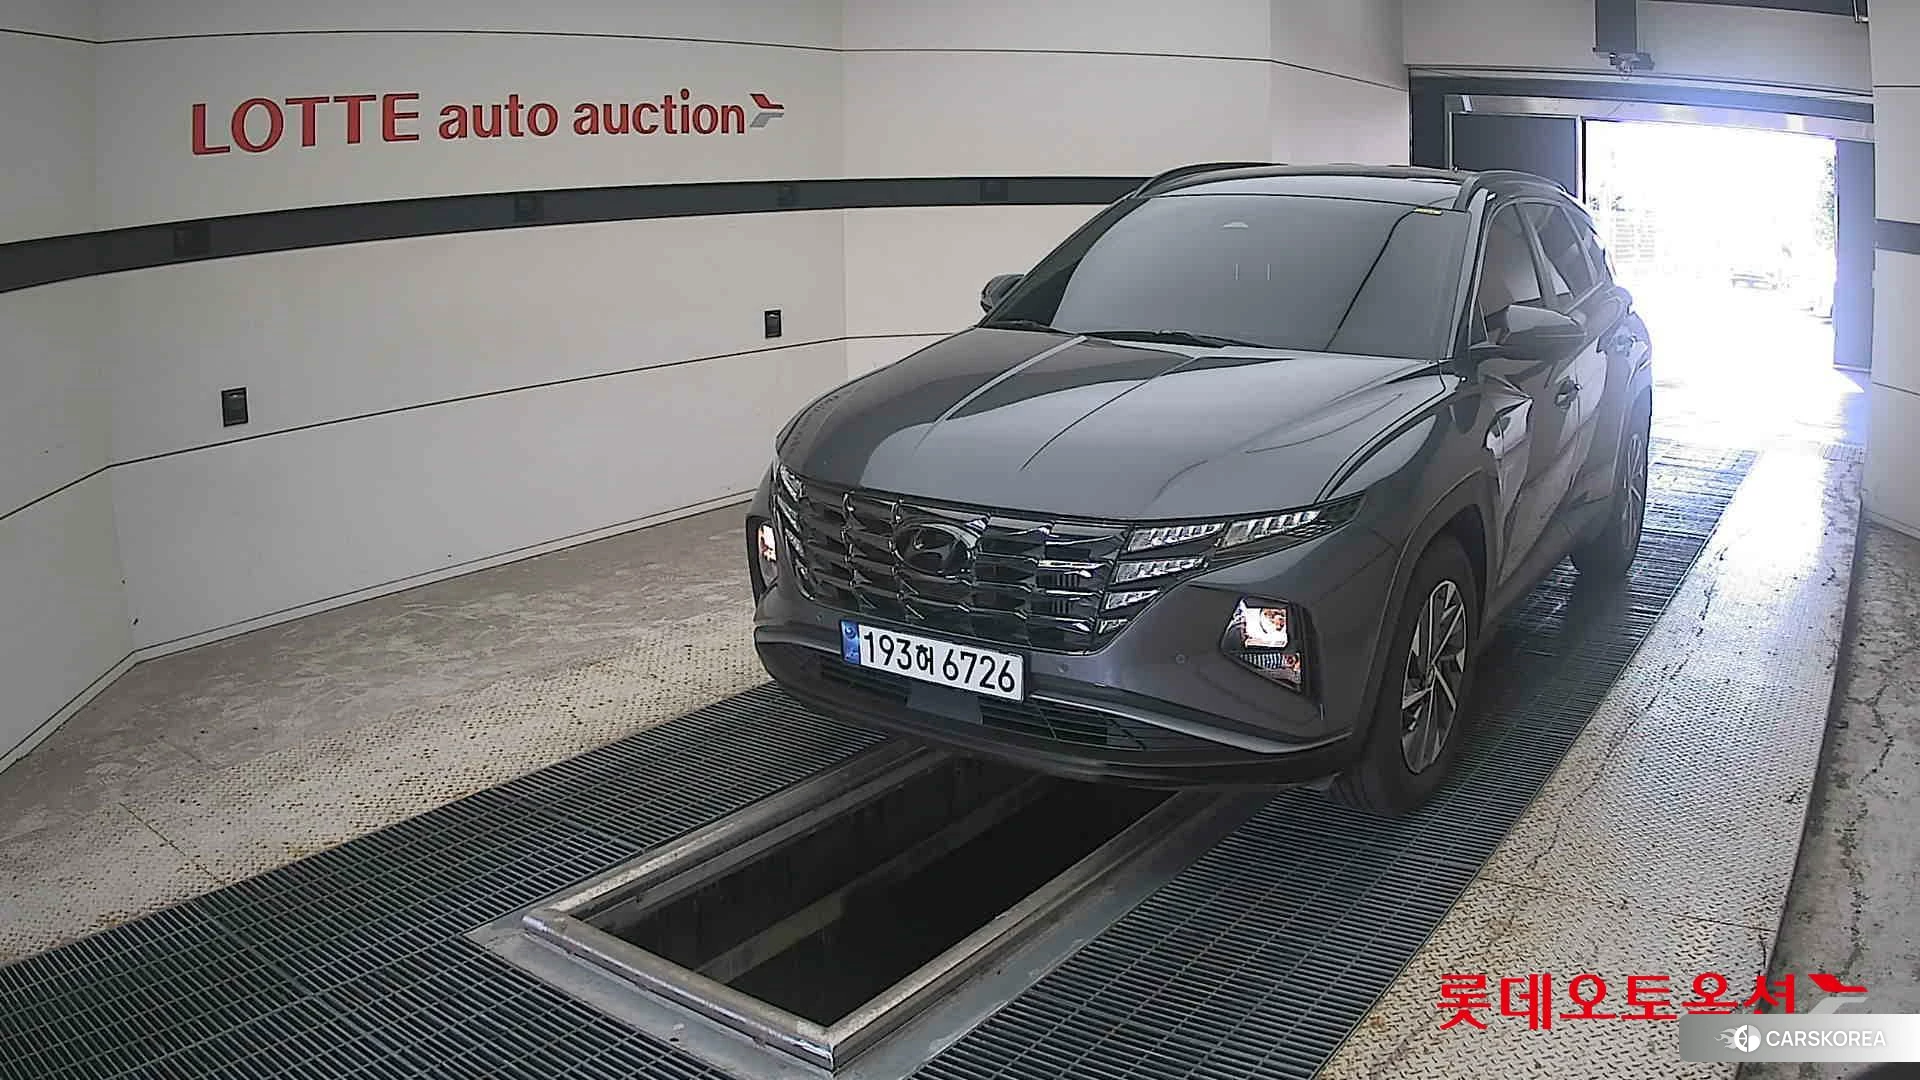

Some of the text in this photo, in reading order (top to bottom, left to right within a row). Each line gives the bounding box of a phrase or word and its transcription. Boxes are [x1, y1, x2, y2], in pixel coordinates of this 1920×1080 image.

[191, 88, 746, 155] LOTTE auto auction
[863, 631, 1016, 693] 193허 6726
